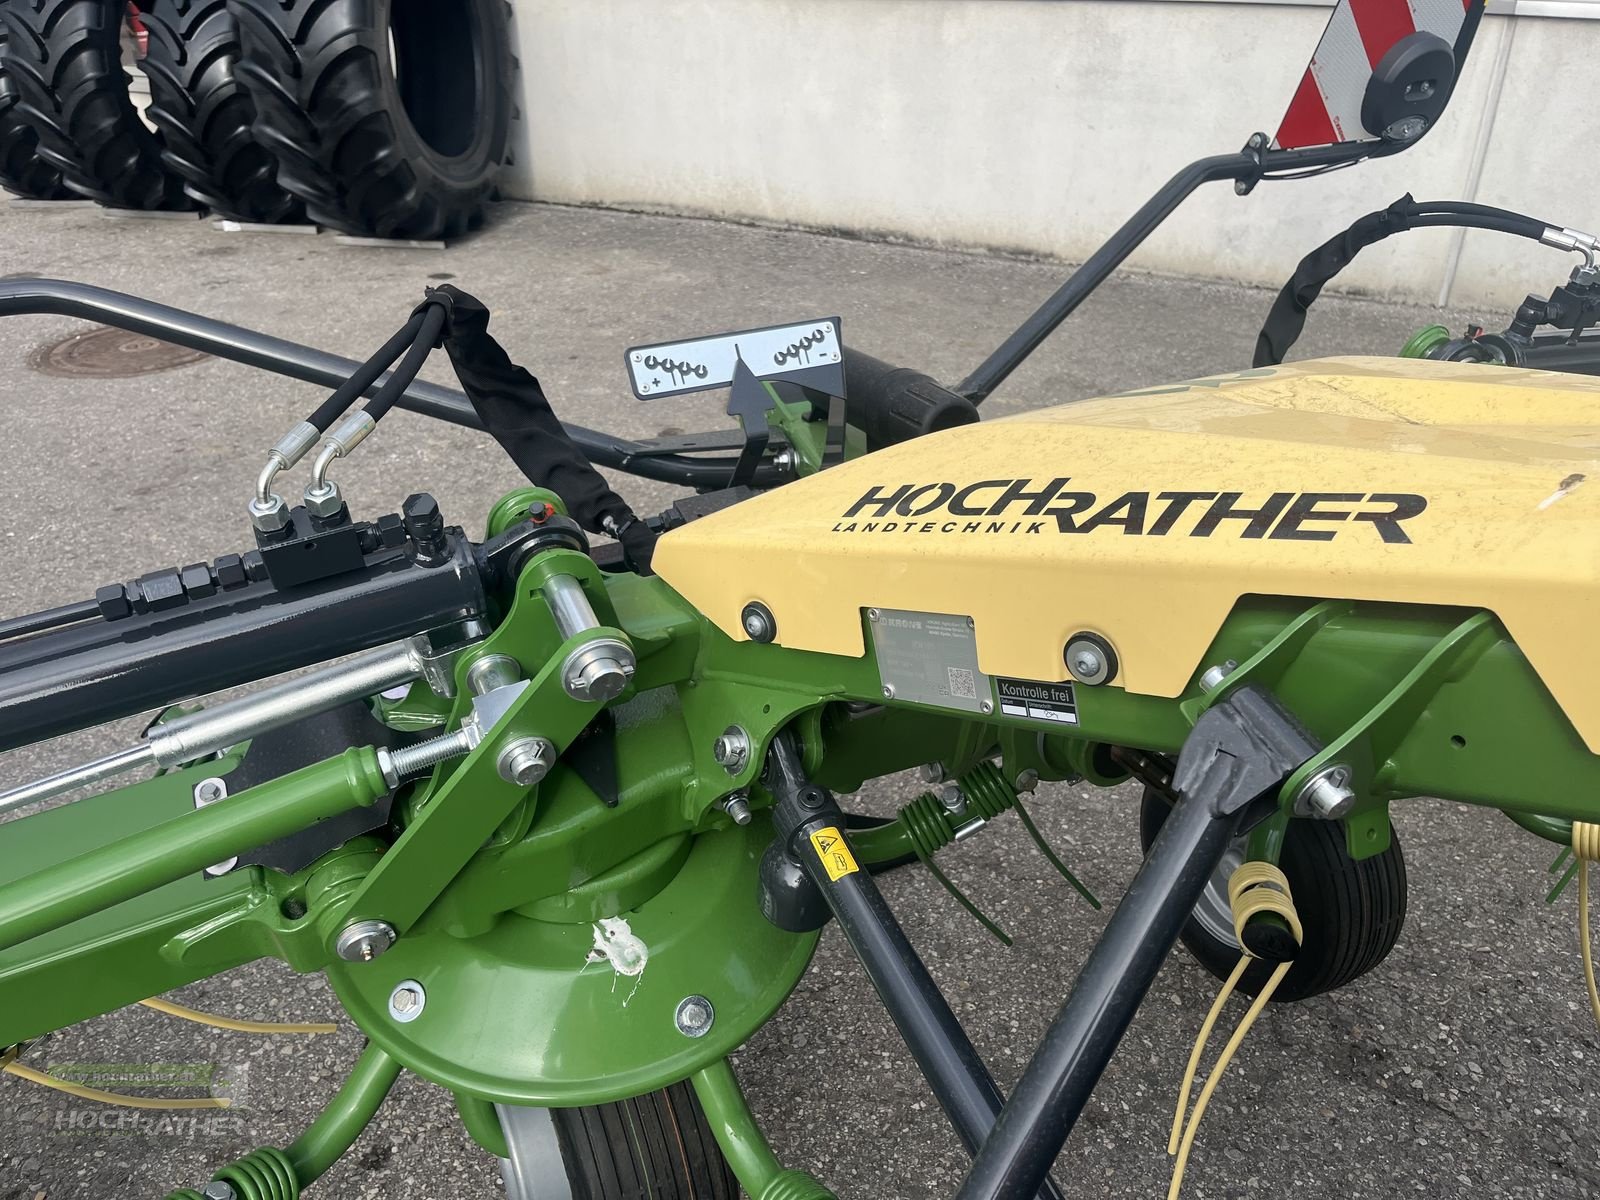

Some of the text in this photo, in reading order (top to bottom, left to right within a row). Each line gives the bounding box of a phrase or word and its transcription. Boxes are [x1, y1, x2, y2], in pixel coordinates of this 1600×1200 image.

[842, 477, 1428, 544] HOCHRATHER
[832, 521, 1046, 534] LANDTECHNIK
[1001, 683, 1070, 702] Kontrolle frei
